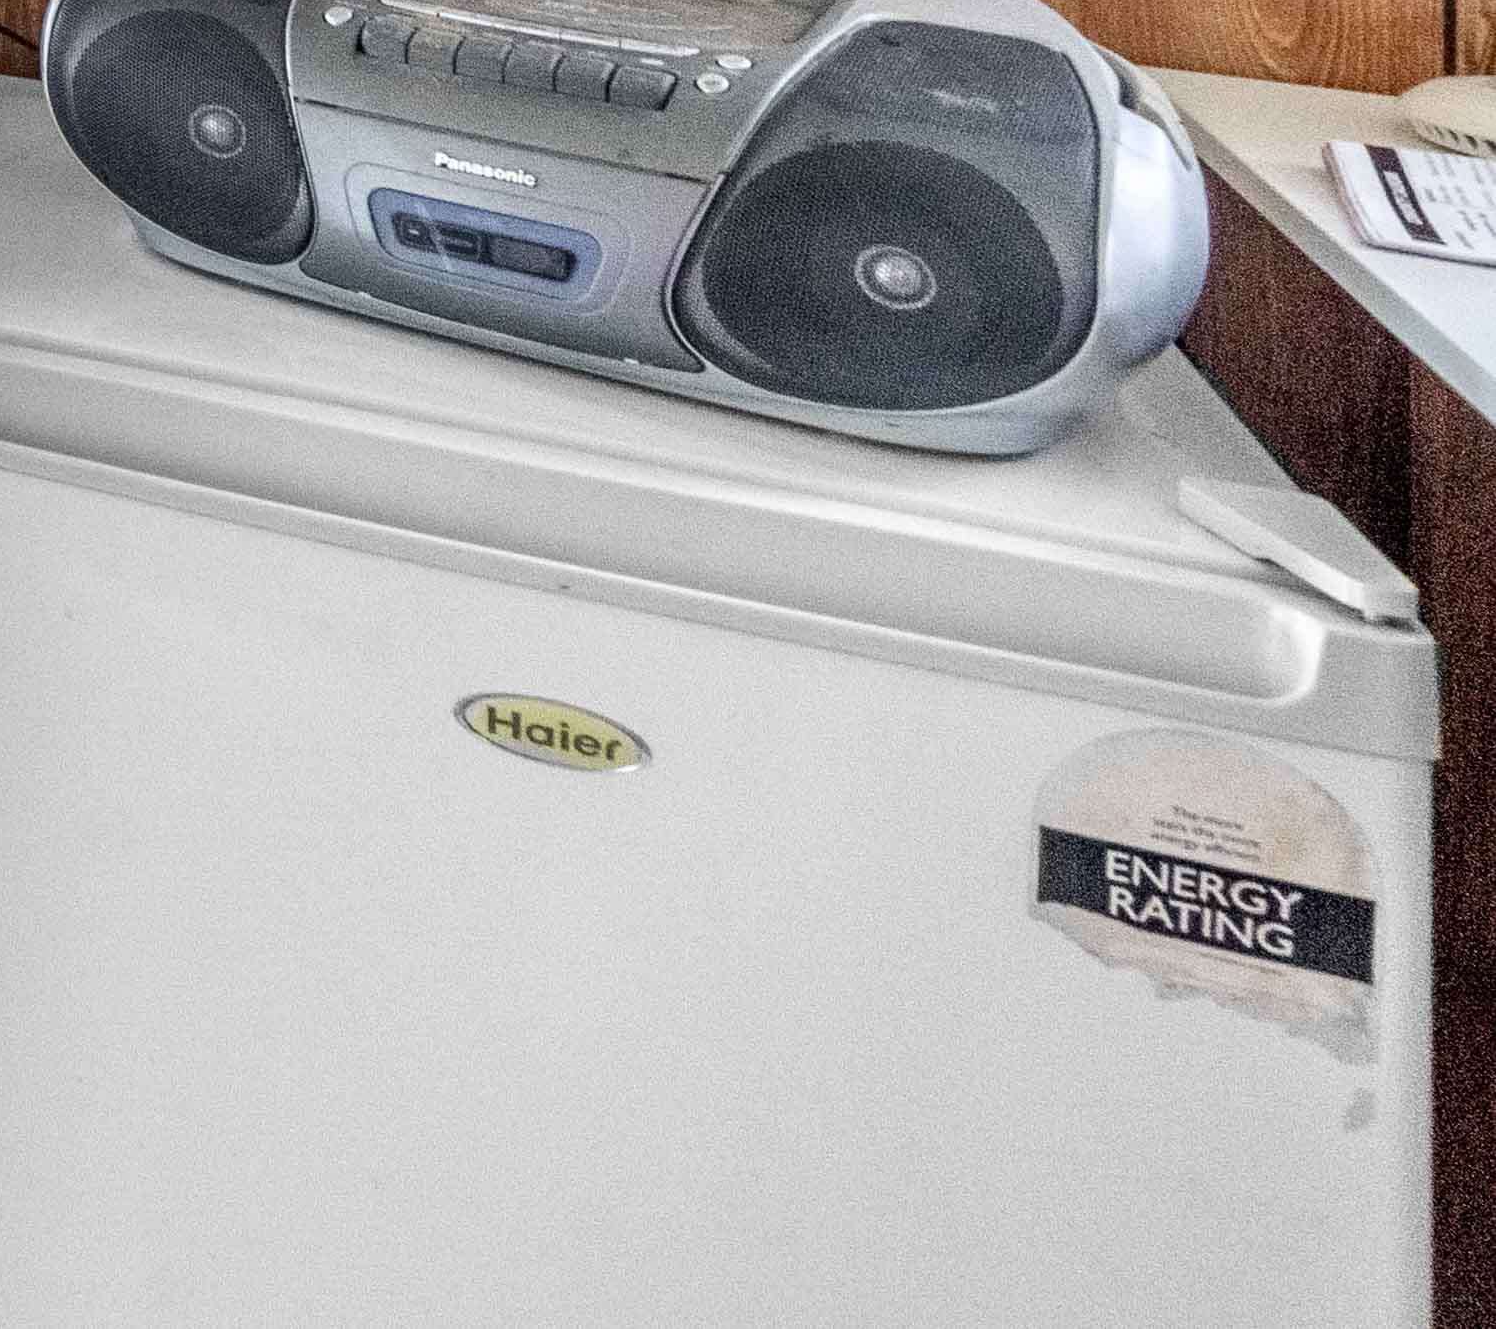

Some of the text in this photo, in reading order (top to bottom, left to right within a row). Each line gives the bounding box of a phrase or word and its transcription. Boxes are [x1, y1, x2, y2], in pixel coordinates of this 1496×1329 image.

[434, 151, 538, 188] Panasonic
[486, 705, 623, 761] Haier
[1104, 849, 1303, 922] ENERGY
[1109, 884, 1295, 958] RATING
